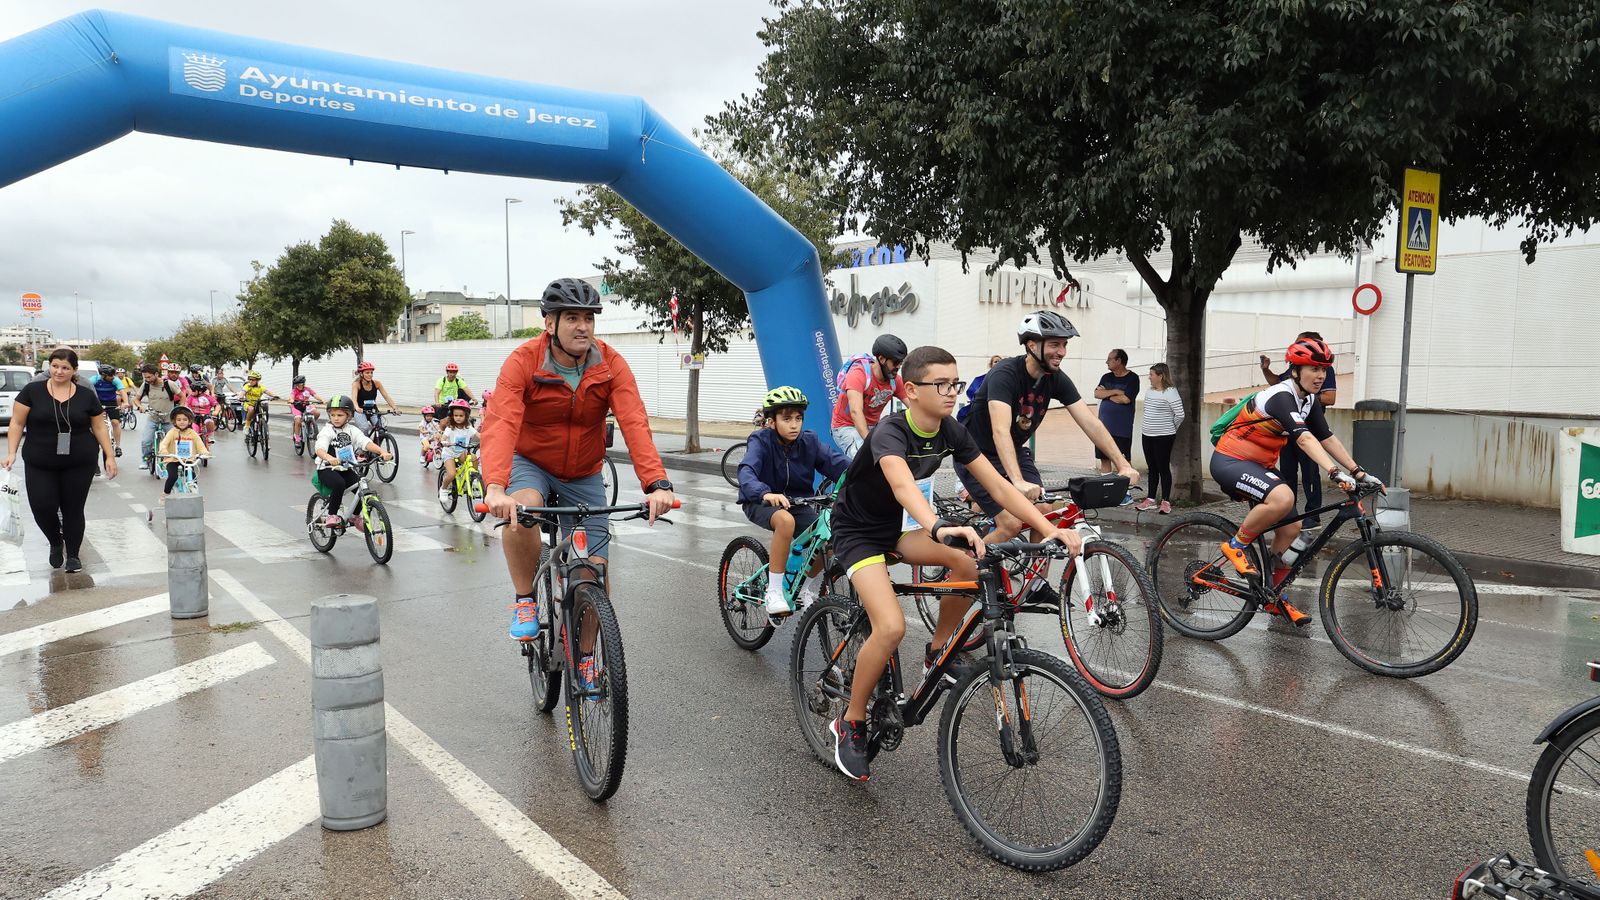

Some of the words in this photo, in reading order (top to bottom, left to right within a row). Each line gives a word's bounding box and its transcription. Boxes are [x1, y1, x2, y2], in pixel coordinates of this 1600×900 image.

[239, 84, 356, 112] Deportes
[240, 66, 477, 113] Ayuntamiento
[484, 103, 519, 119] de
[526, 108, 597, 129] Jerez
[1403, 253, 1432, 268] PEATONES
[1240, 473, 1270, 491] SYMISUR
[565, 705, 576, 751] MAXXIS
